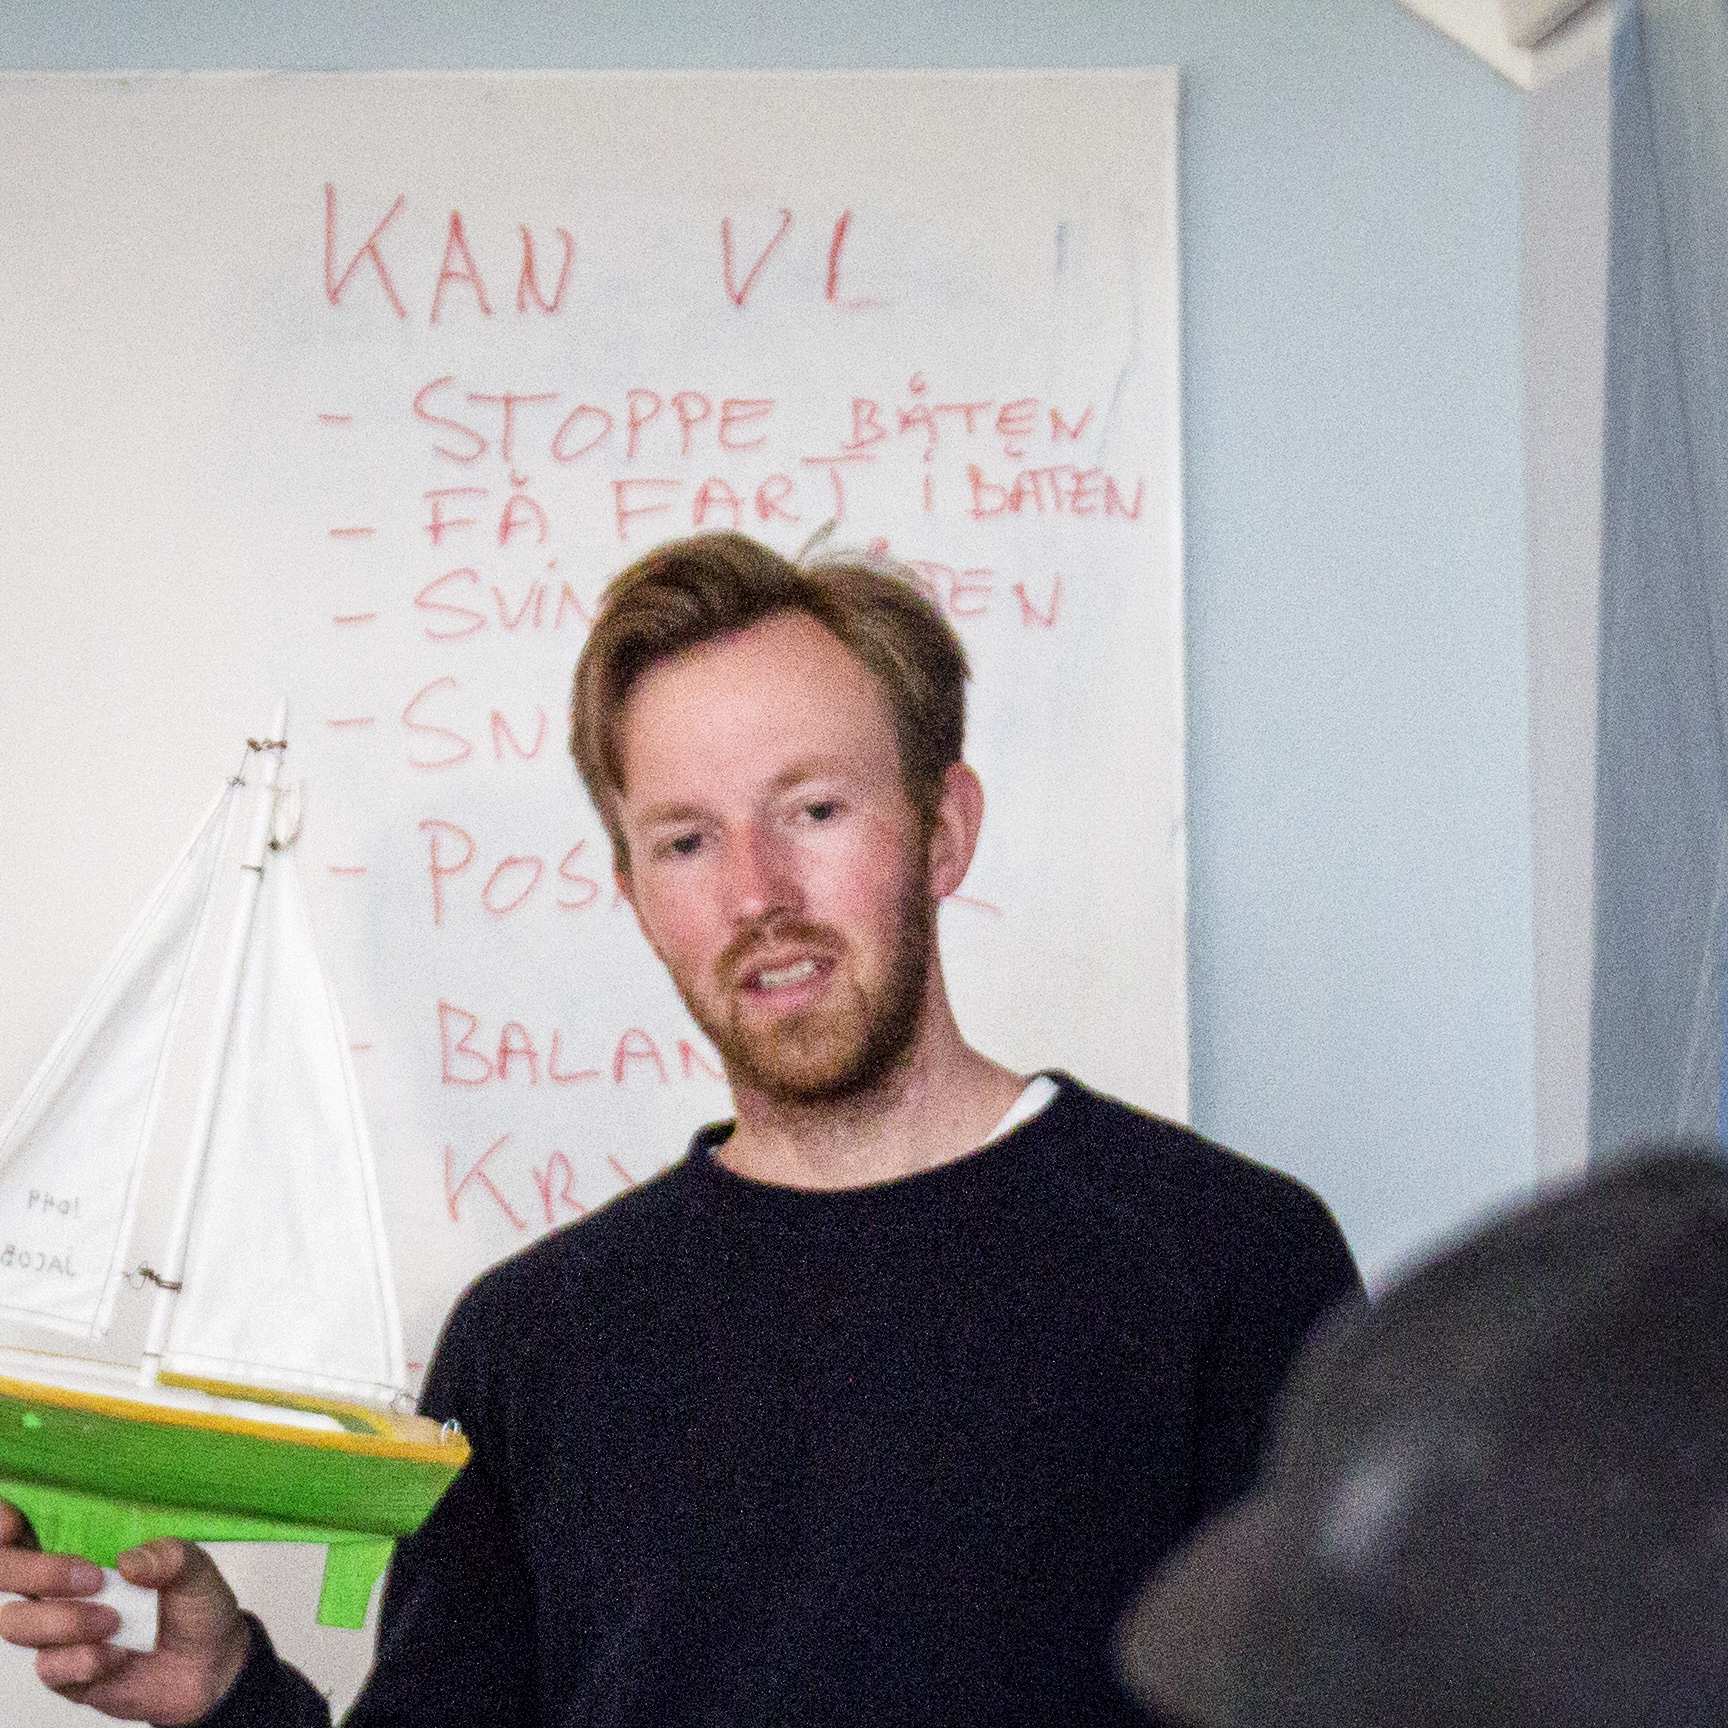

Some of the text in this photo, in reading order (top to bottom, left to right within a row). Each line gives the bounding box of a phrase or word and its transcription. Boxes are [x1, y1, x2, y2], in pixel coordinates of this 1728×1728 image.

[324, 180, 577, 324] KAN
[412, 375, 777, 465] STOPPE
[400, 675, 550, 772] SN
[418, 818, 622, 927] POS
[437, 998, 728, 1087] BALAN
